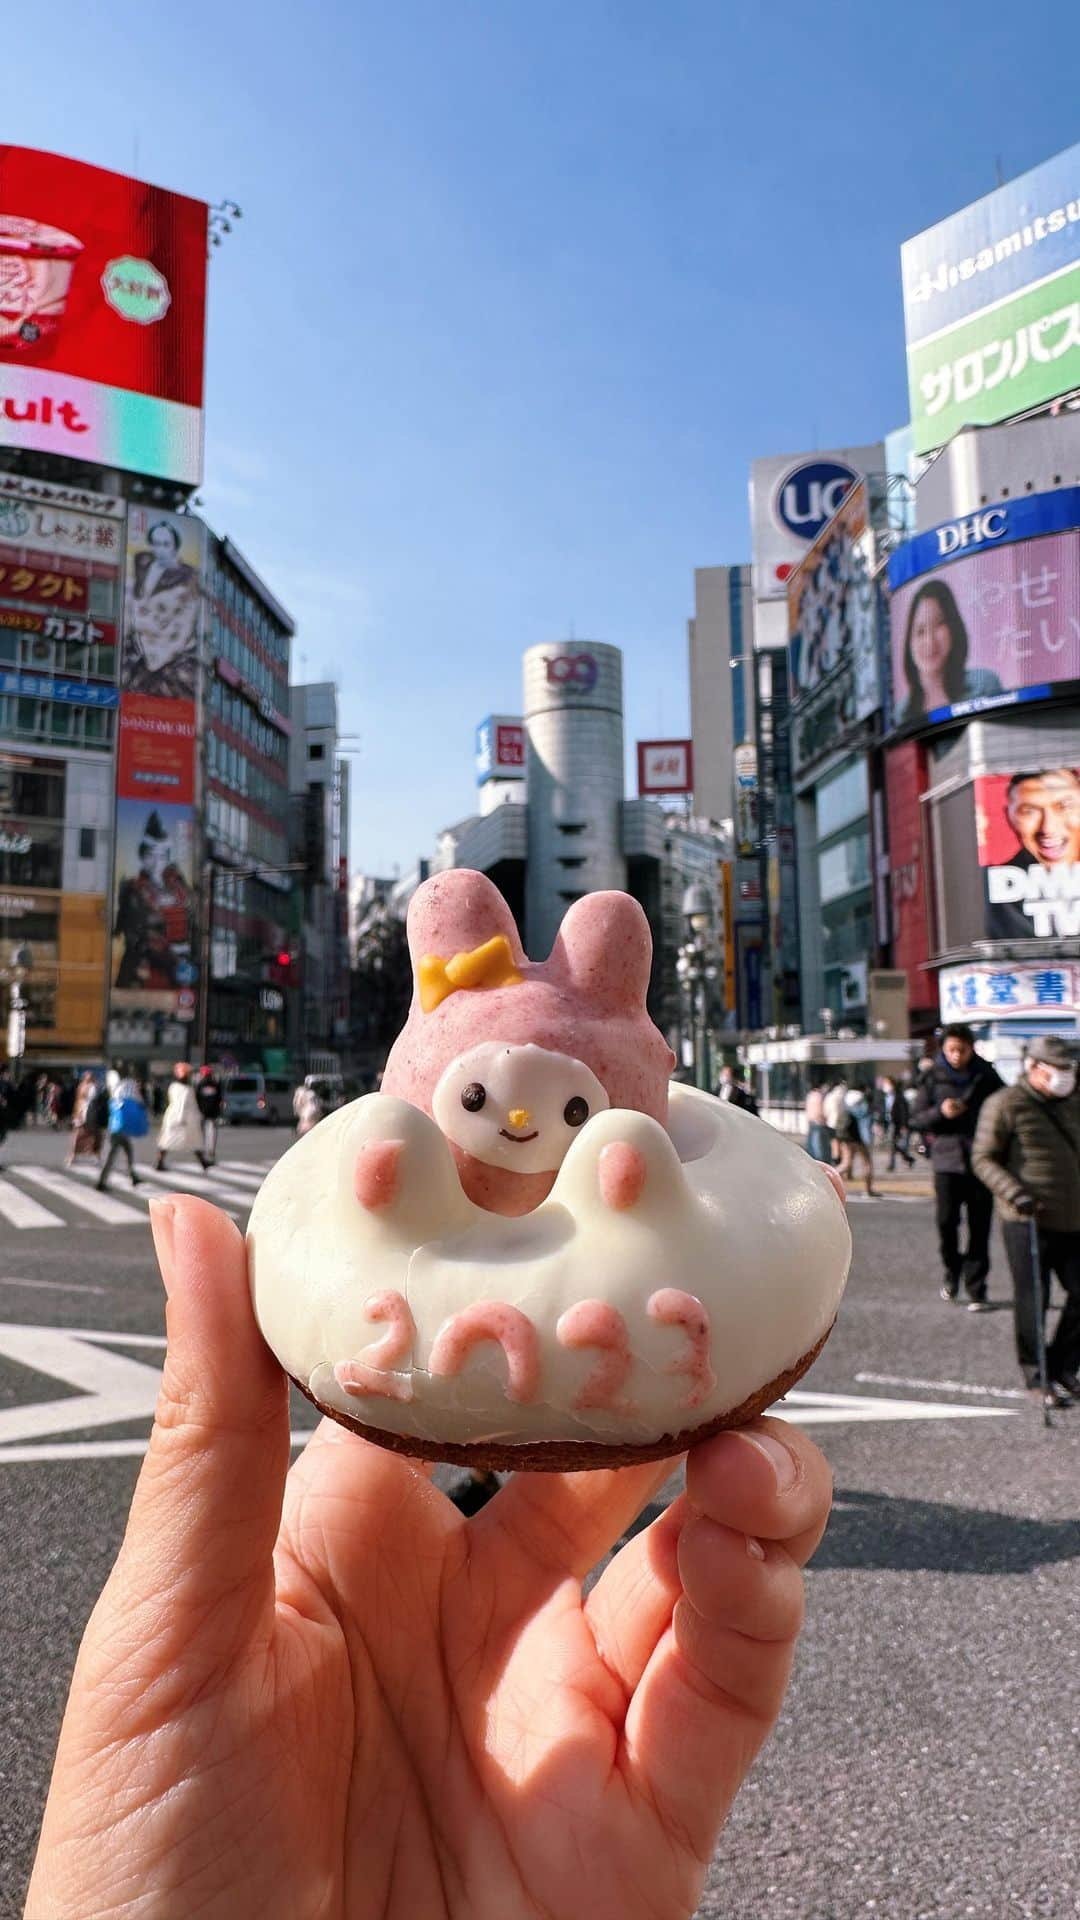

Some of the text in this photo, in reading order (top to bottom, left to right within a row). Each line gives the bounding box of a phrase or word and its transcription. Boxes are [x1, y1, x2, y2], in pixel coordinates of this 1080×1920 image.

[0, 395, 90, 433] ult
[936, 508, 1008, 557] DHC
[0, 568, 84, 602] タクト
[45, 616, 105, 644] ガスト
[987, 863, 1080, 905] DM
[333, 1287, 718, 1420] 2023
